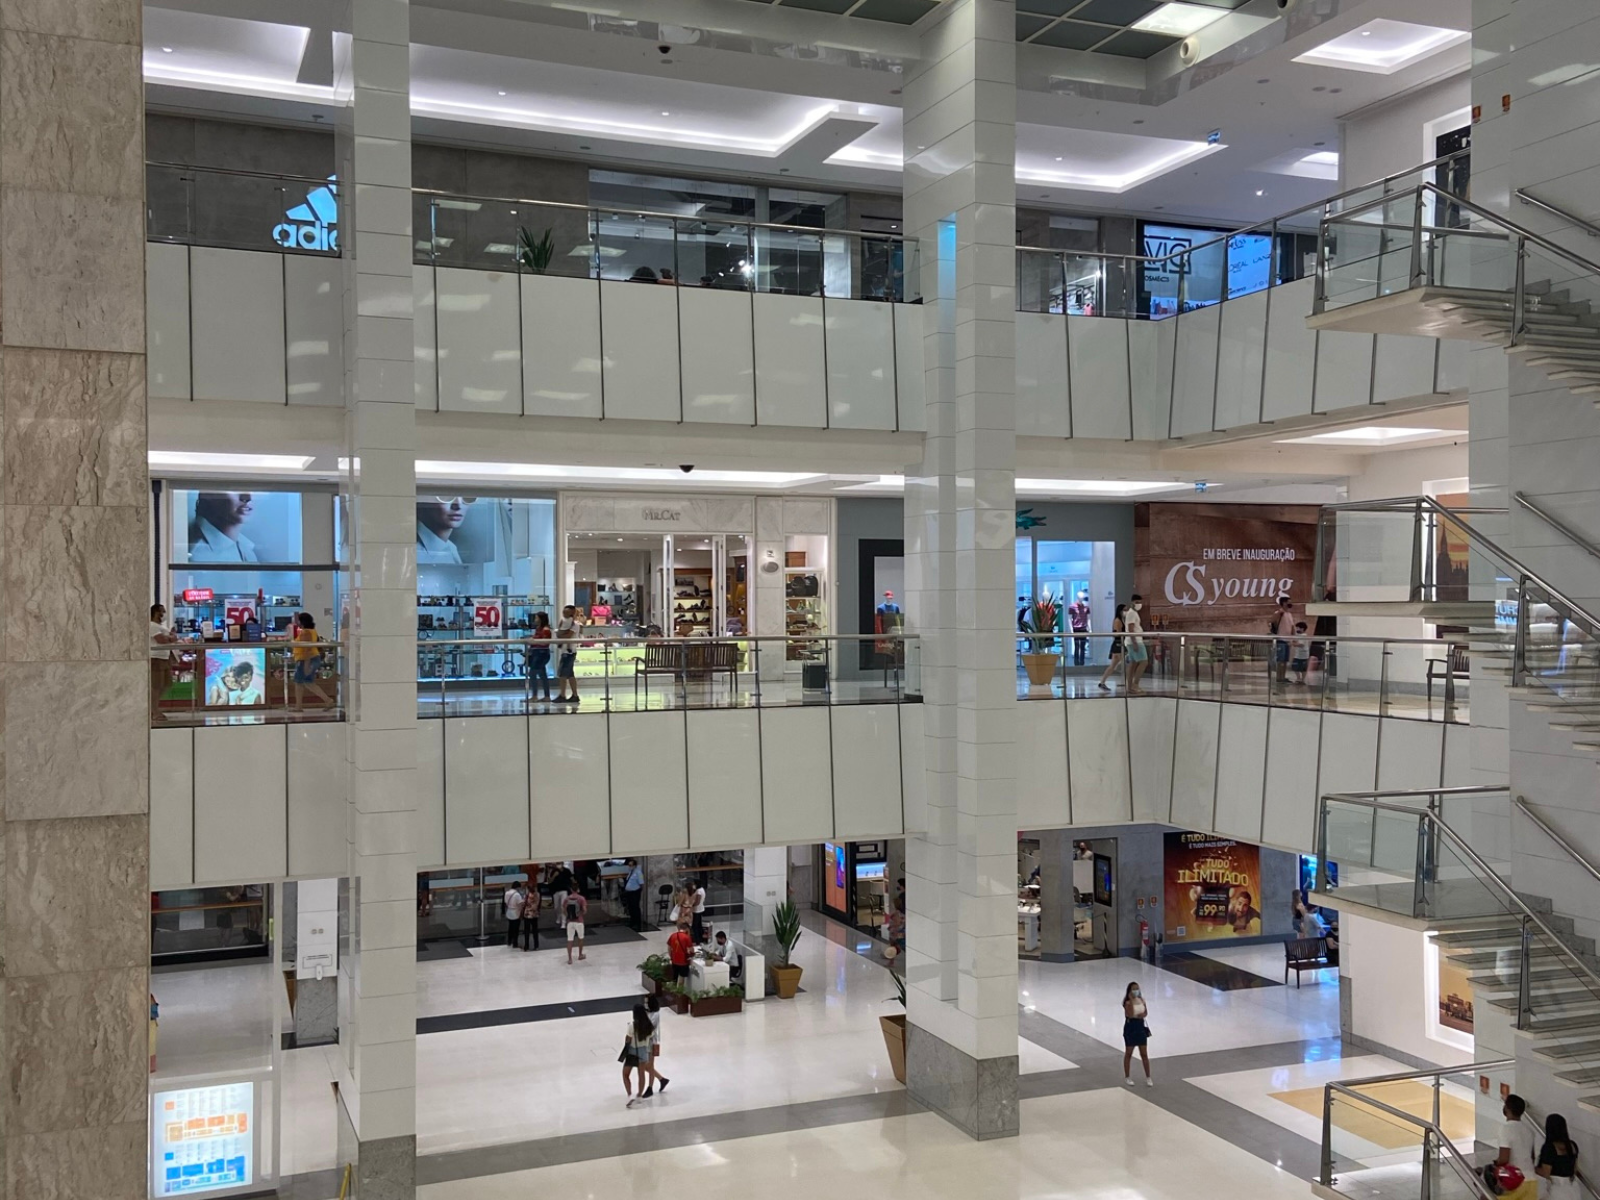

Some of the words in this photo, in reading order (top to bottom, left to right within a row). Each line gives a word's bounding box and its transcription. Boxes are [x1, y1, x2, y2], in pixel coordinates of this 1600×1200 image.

[1203, 548, 1215, 560] EM
[1216, 548, 1241, 560] BREVE
[1243, 547, 1295, 562] INAUGURAÇÃO
[1207, 578, 1293, 605] young
[226, 606, 255, 625] 50
[474, 606, 501, 628] 50
[1181, 833, 1187, 842] É
[1187, 834, 1205, 842] TUDO
[1206, 858, 1230, 869] TUDO
[1177, 869, 1249, 887] ILIMITADO
